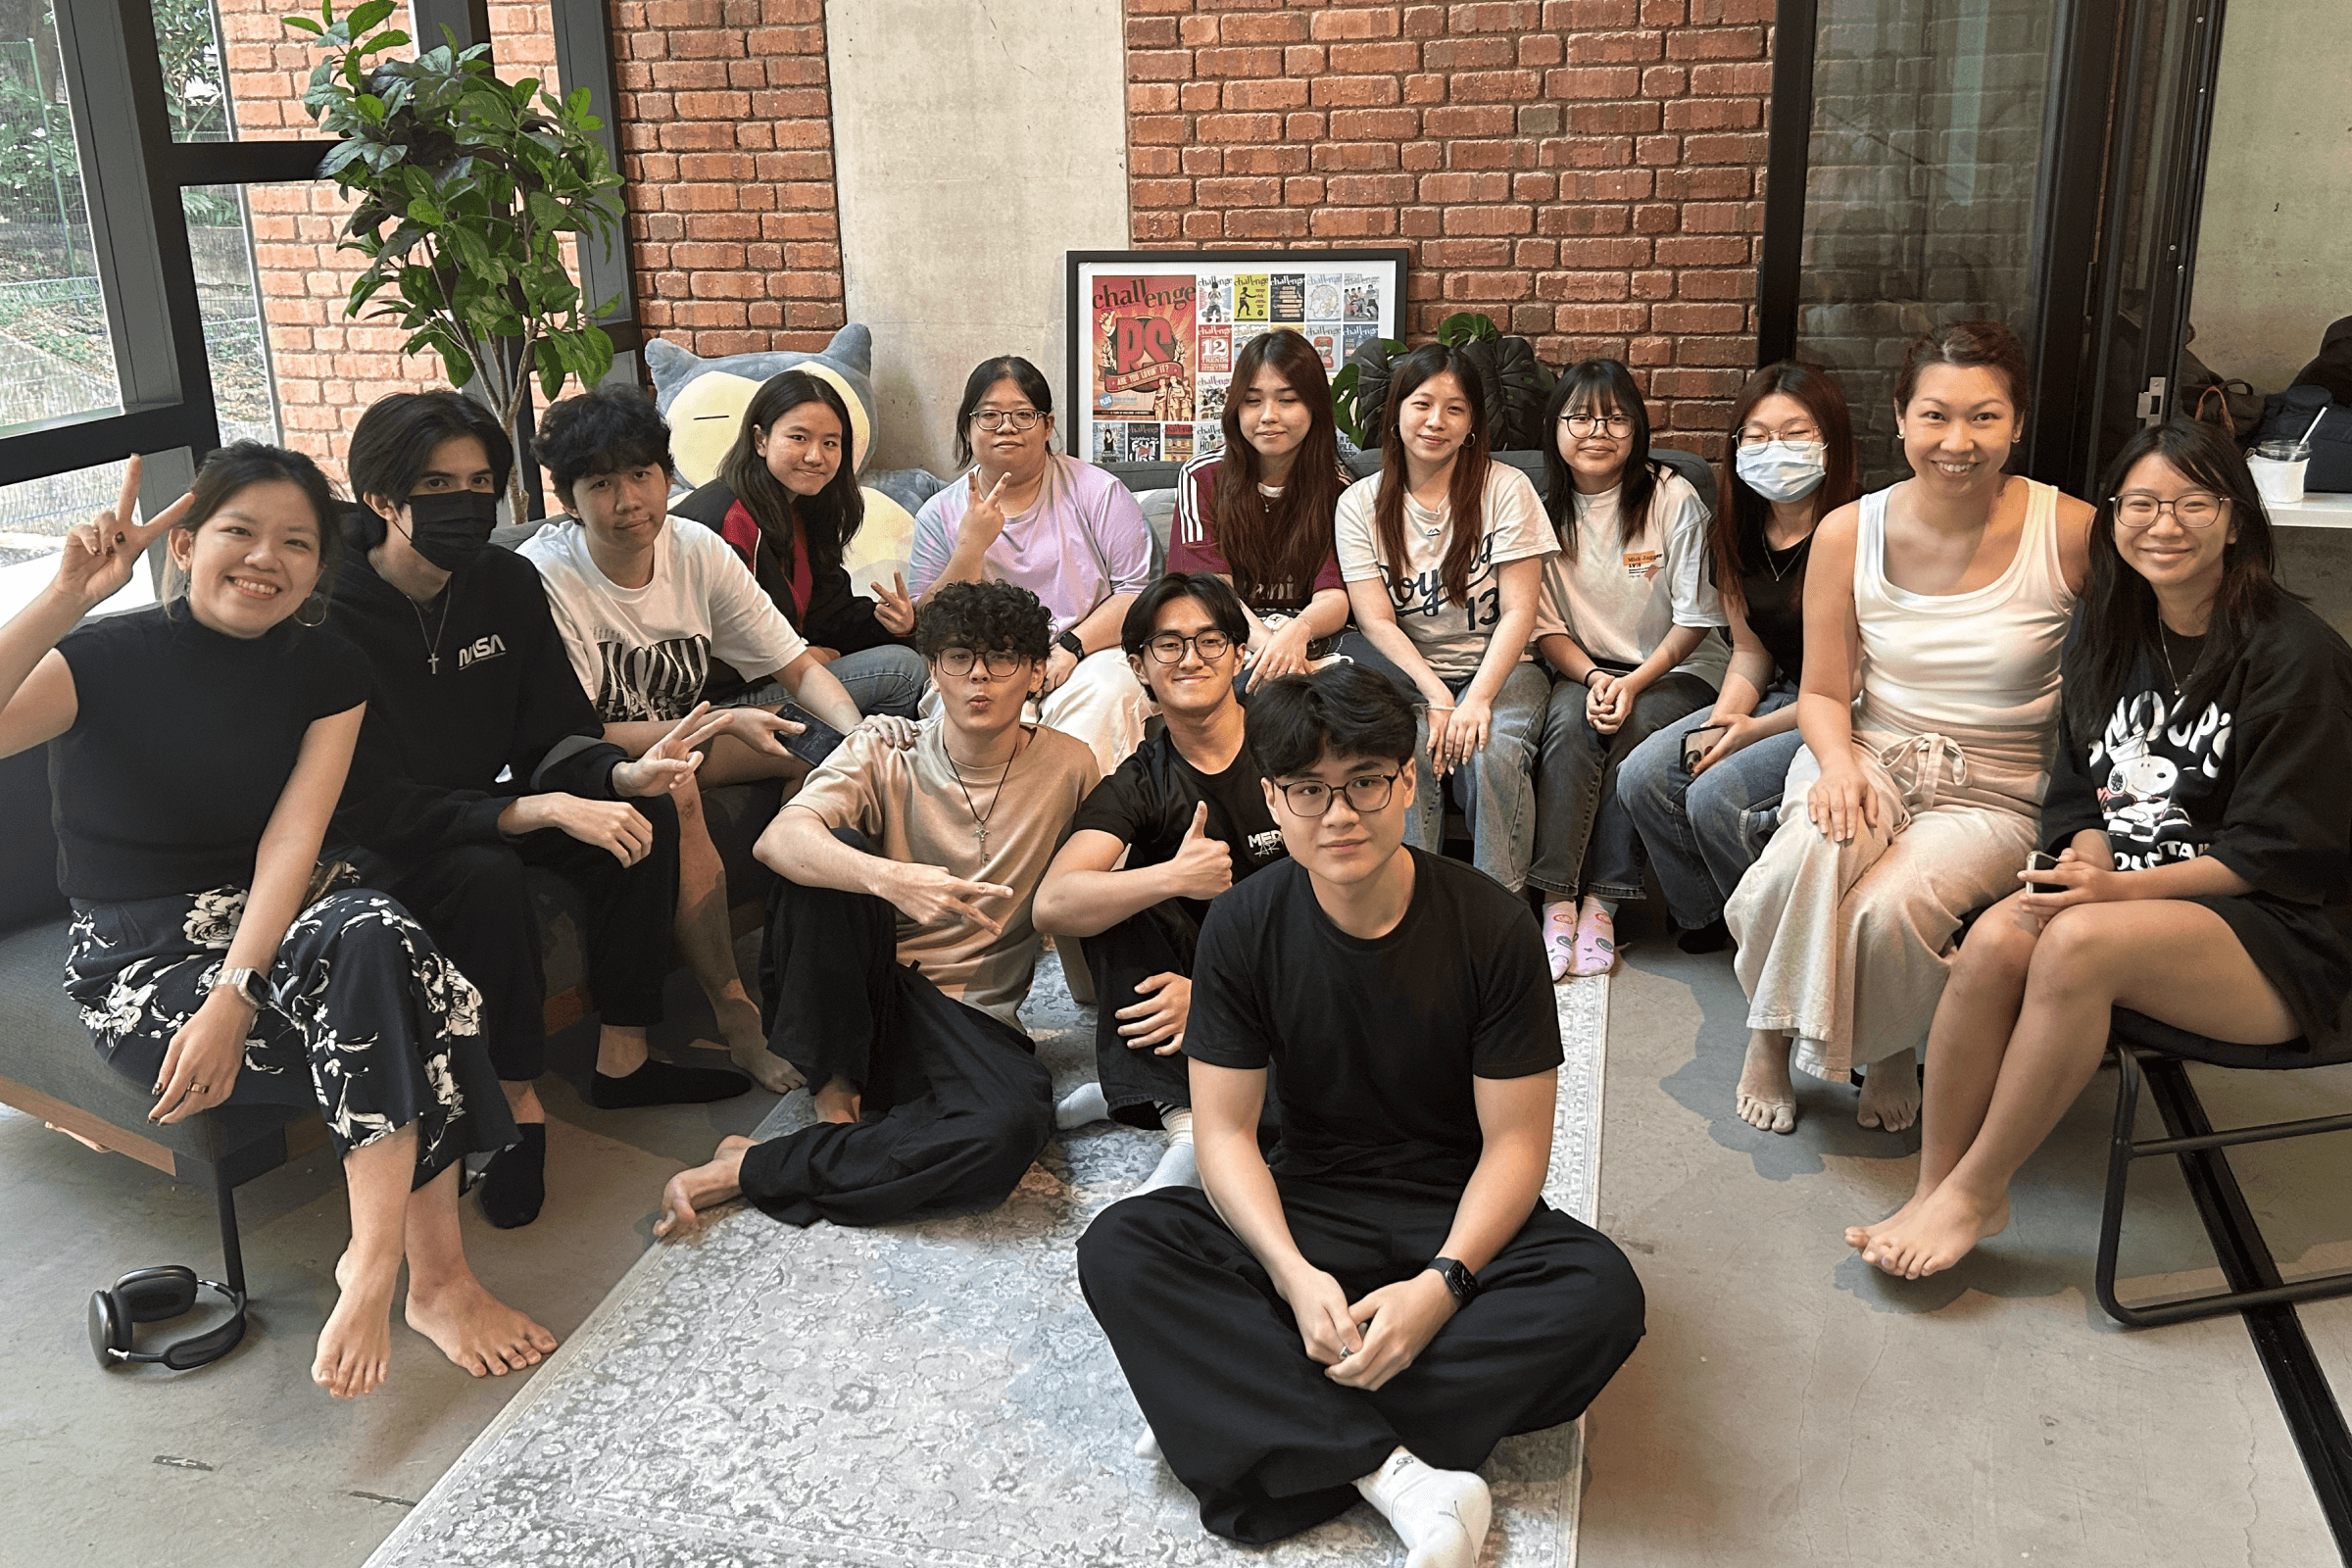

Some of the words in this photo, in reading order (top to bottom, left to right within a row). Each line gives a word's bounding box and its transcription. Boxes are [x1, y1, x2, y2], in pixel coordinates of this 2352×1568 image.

[1093, 278, 1196, 311] challenge
[1201, 338, 1227, 357] 12
[1117, 376, 1128, 385] ARE
[1129, 372, 1140, 382] YOU
[1099, 395, 1112, 407] PLUS
[1465, 587, 1500, 631] 13
